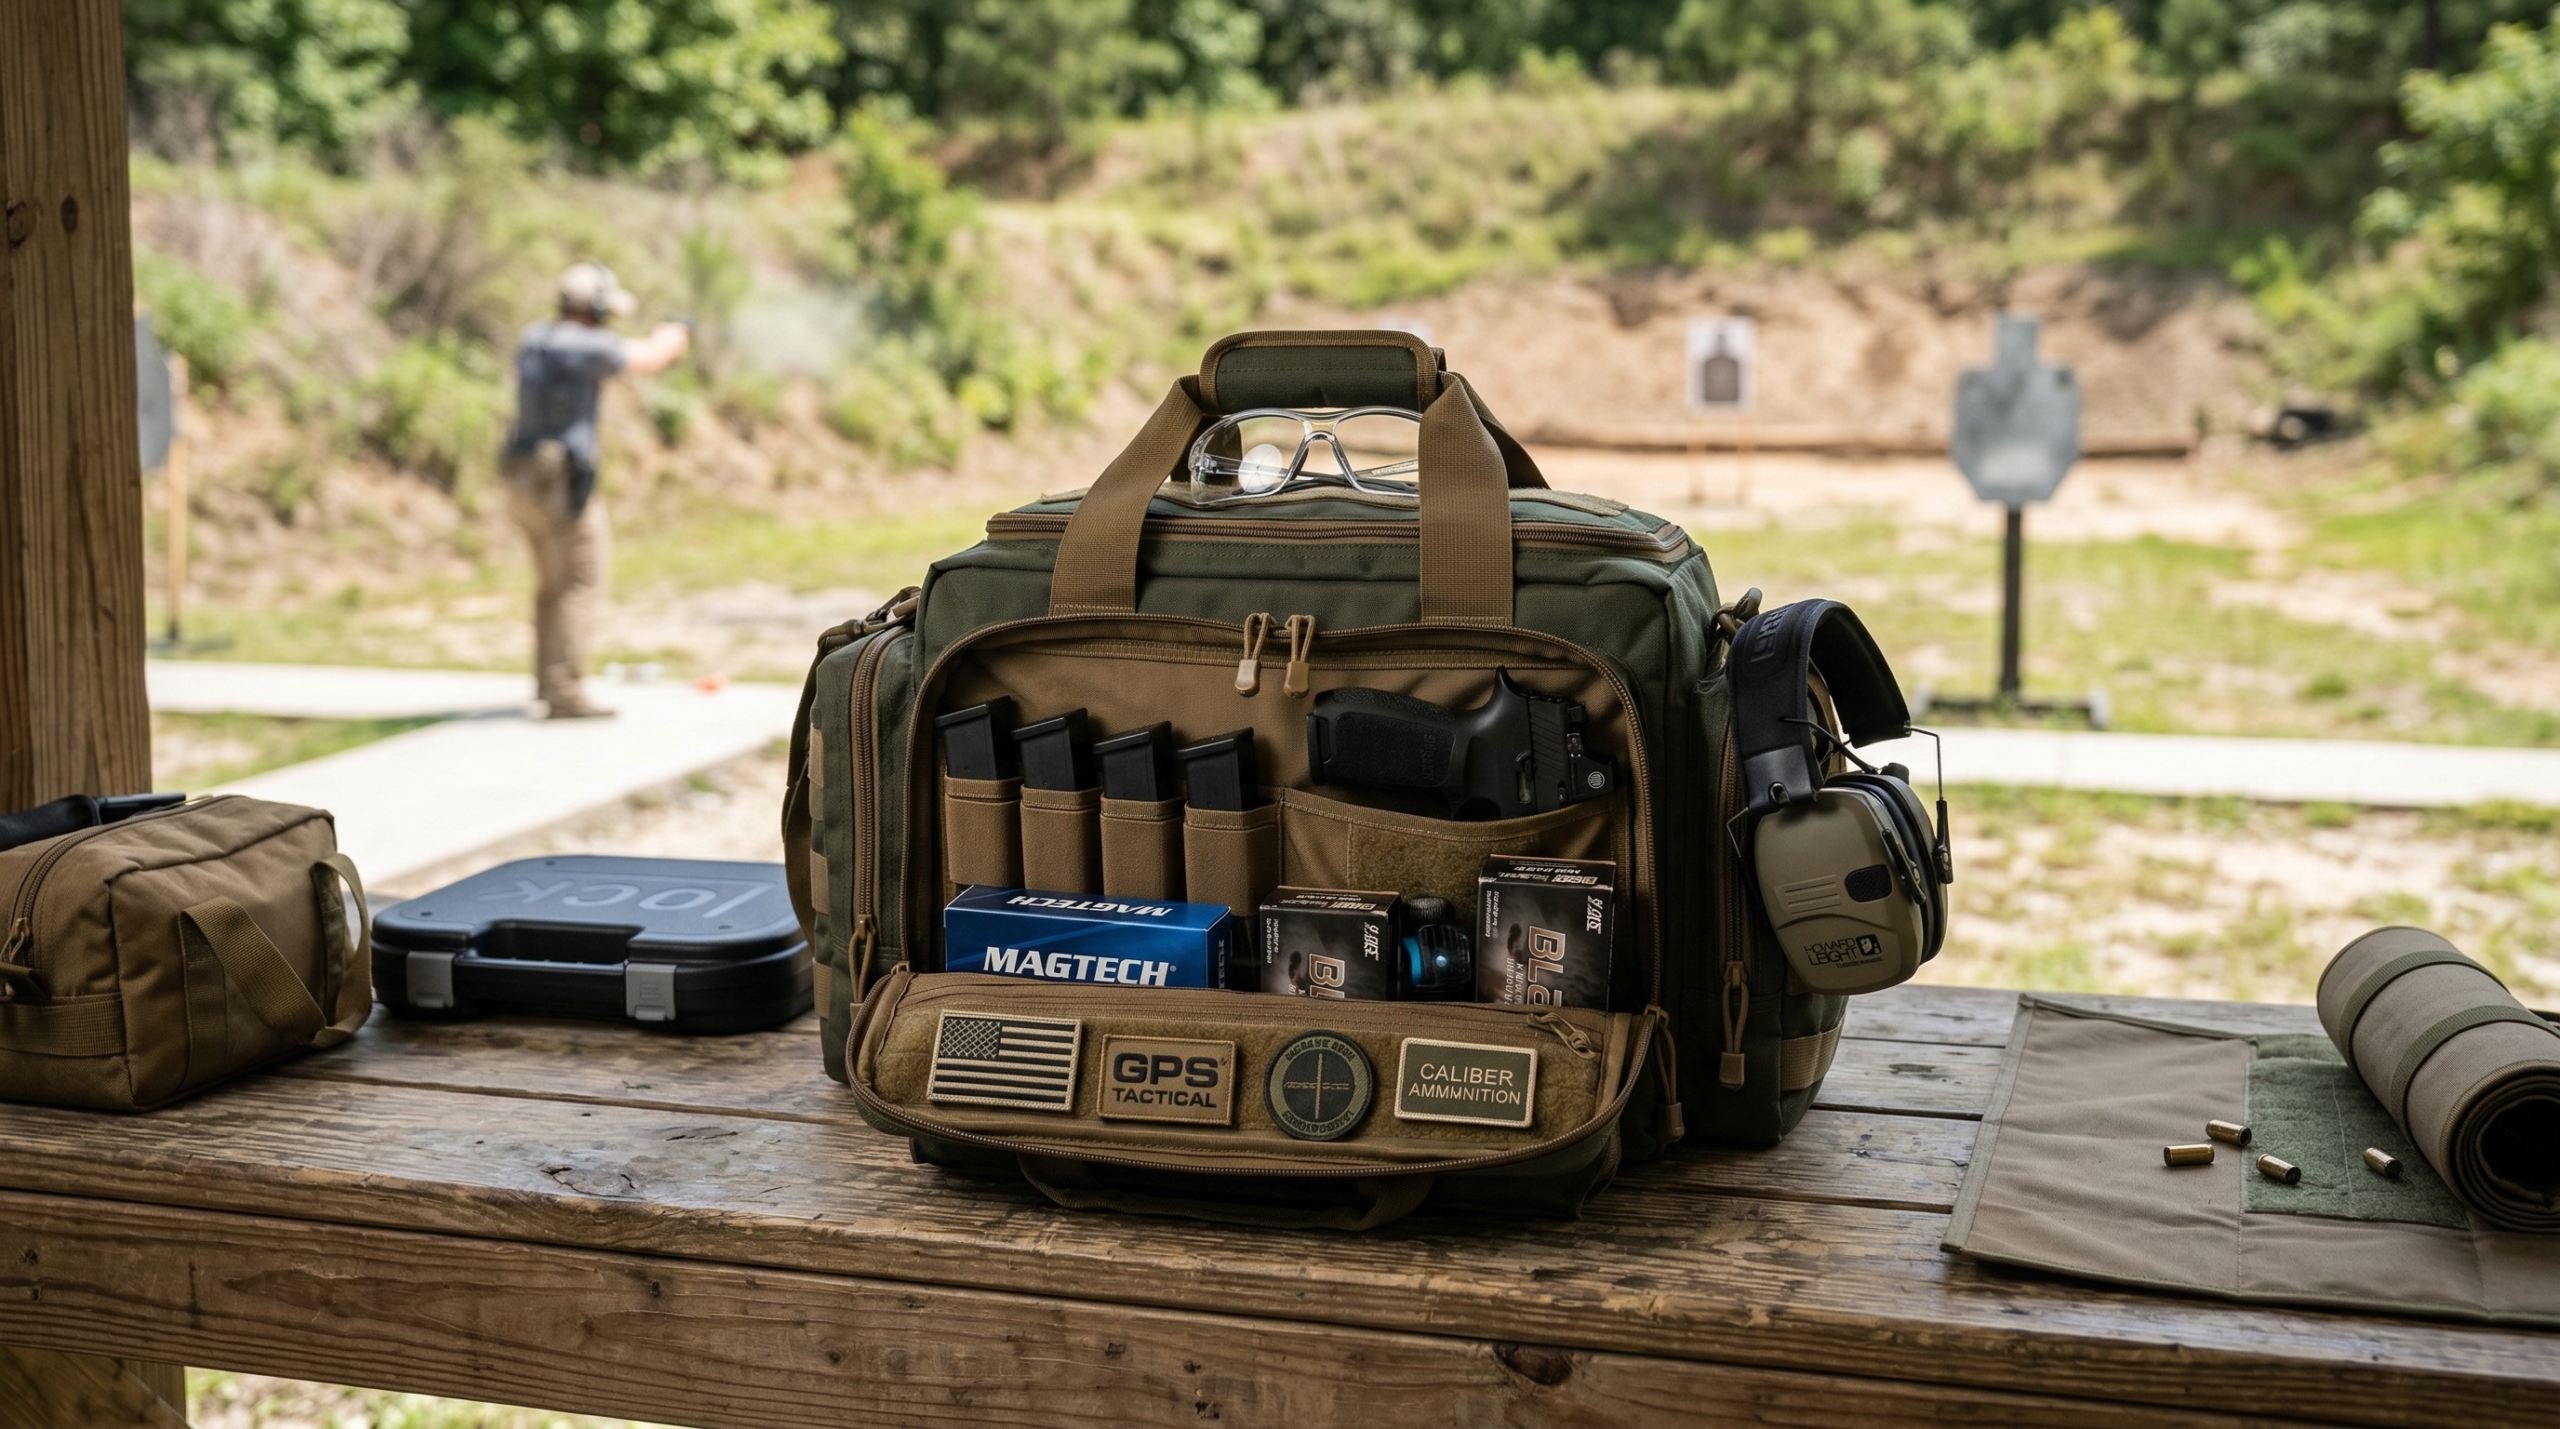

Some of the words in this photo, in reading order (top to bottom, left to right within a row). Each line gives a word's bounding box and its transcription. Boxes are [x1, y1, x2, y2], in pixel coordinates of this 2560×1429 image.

[1007, 895, 1173, 917] MAGTECH
[1808, 947, 1857, 965] LEIGHT
[1420, 1063, 1514, 1087] CALIBER
[1112, 1087, 1217, 1108] TACTICAL
